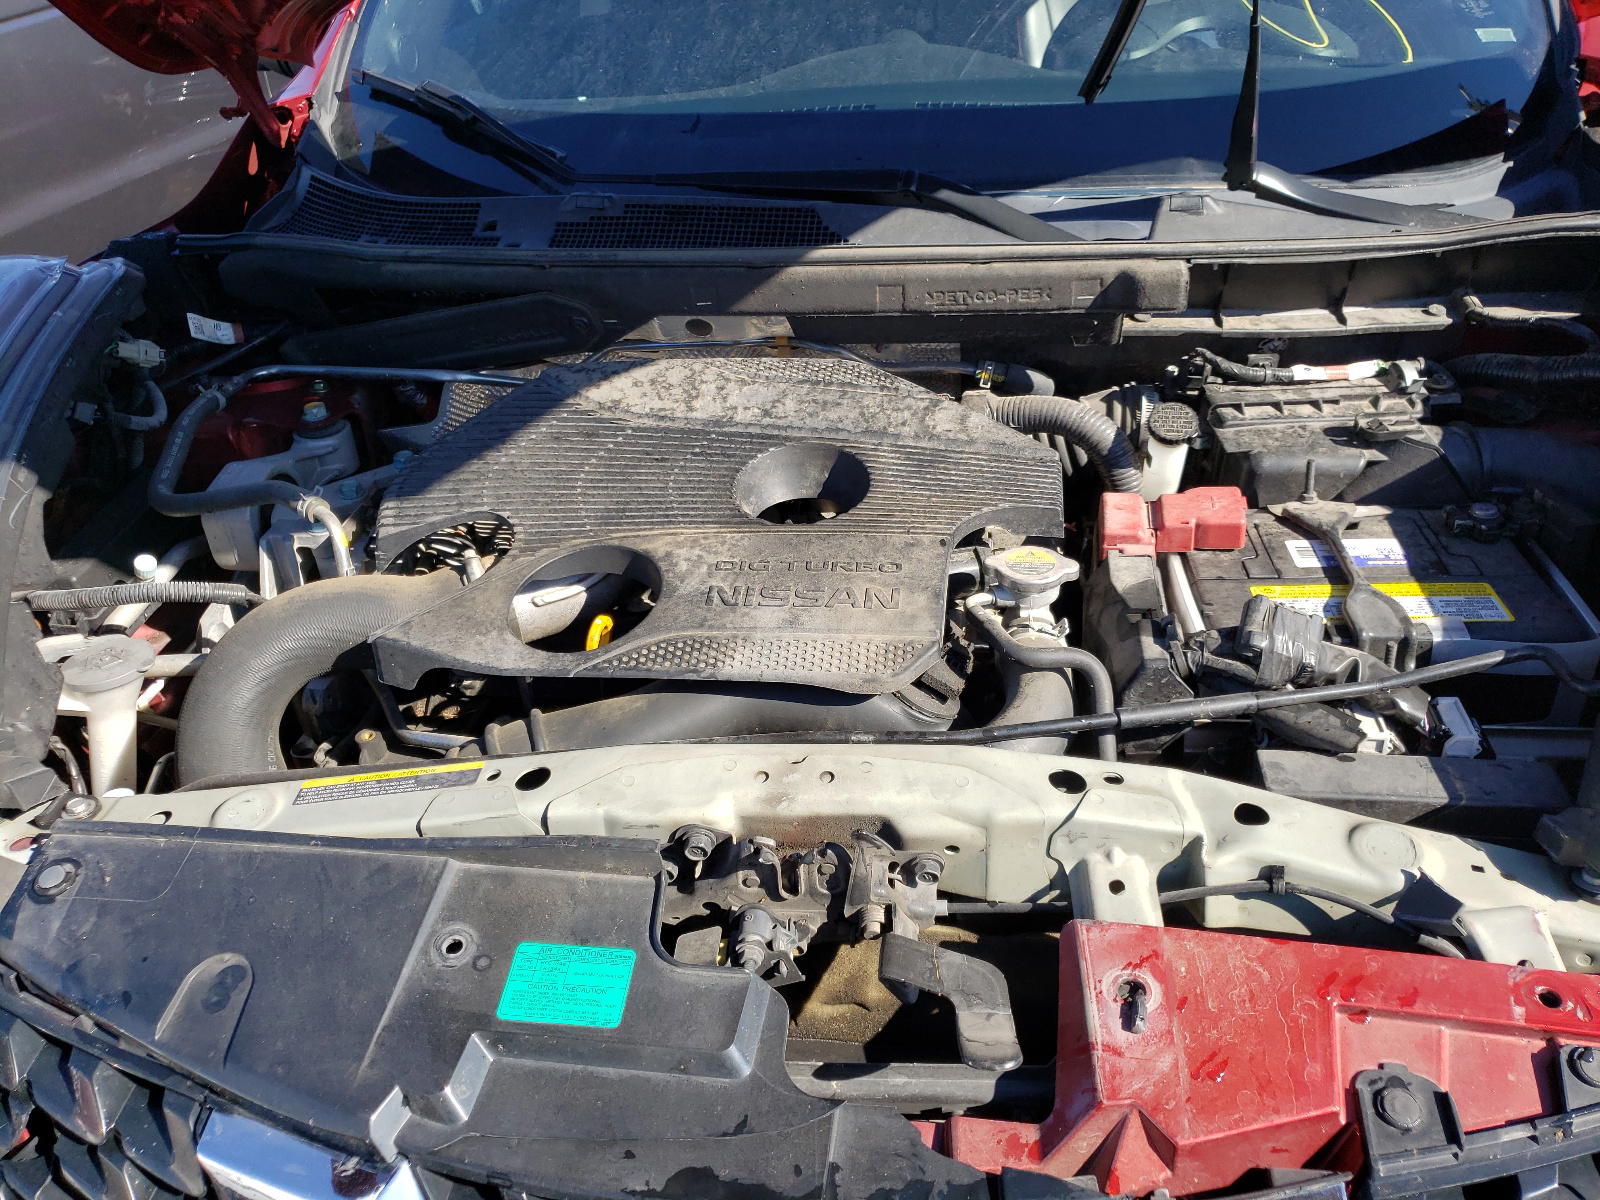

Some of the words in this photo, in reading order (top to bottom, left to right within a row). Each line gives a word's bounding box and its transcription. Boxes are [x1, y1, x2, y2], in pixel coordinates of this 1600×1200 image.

[714, 560, 771, 572] DIG
[780, 559, 903, 573] TURBO
[705, 585, 901, 610] NISSAN
[359, 772, 391, 781] CAUTION
[399, 768, 437, 777] ATTENTION
[557, 947, 614, 958] CONDITIONER
[527, 983, 559, 992] CAUTION
